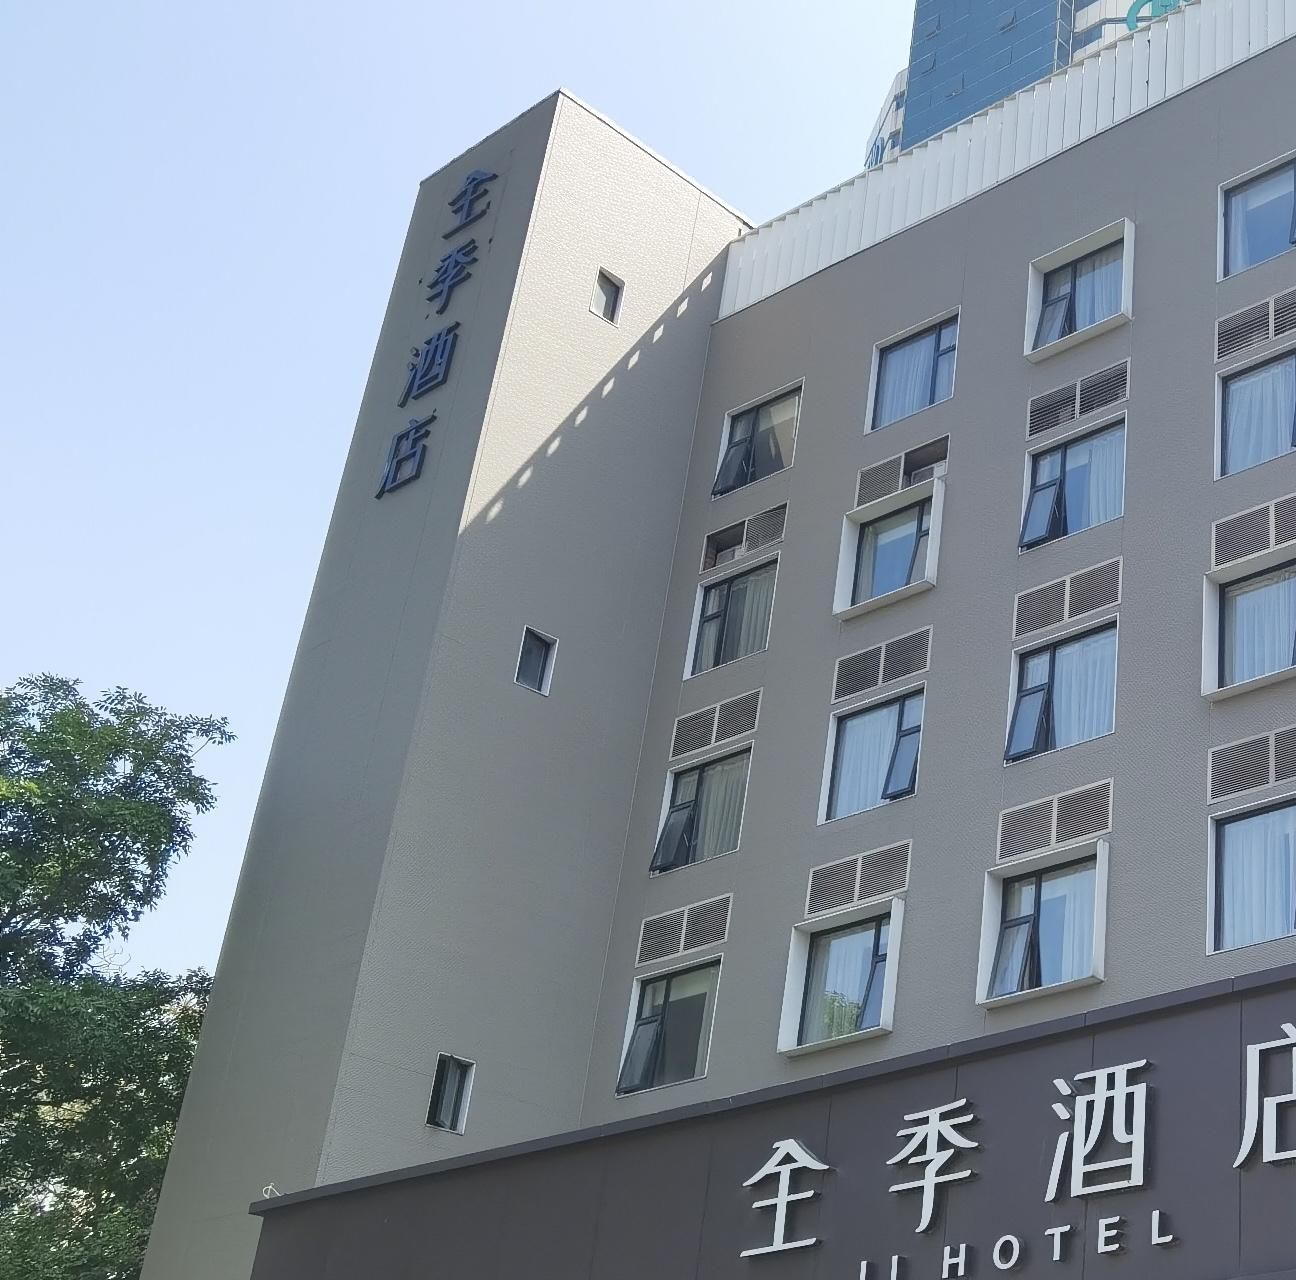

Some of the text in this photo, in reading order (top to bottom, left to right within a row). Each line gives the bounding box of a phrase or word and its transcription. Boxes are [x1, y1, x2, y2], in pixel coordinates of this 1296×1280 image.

[374, 169, 498, 500] 全季酒店
[942, 1209, 1174, 1279] HOTEL
